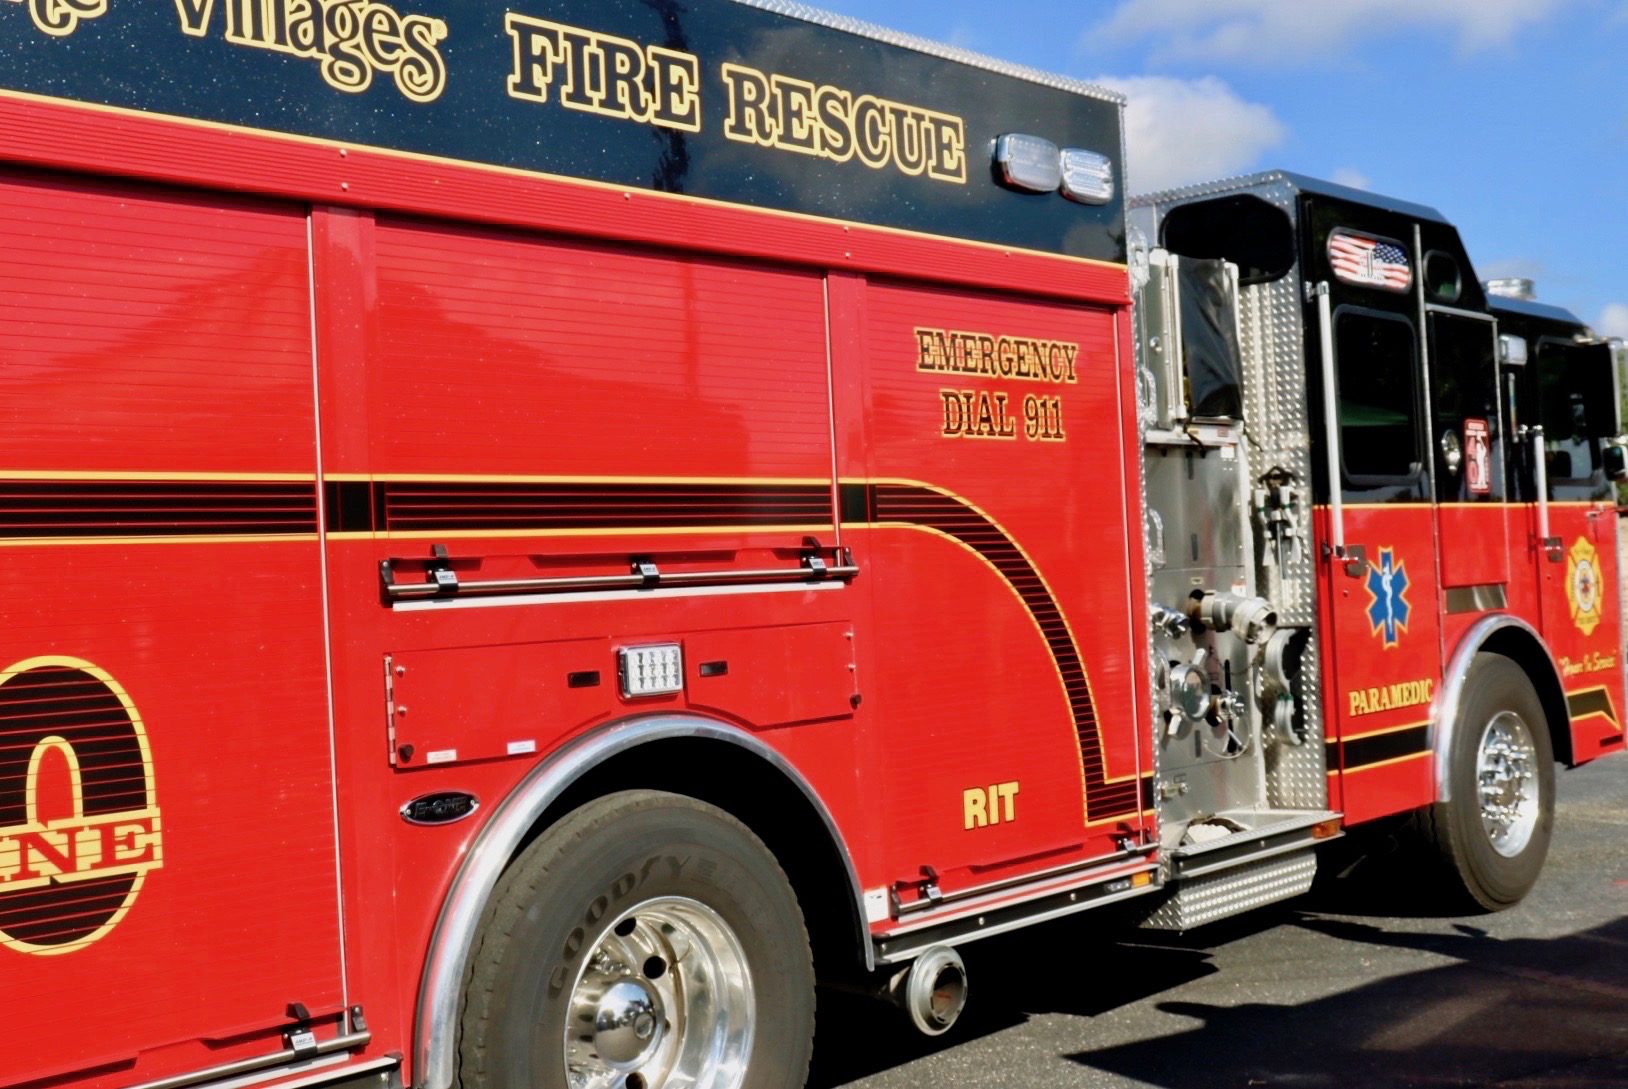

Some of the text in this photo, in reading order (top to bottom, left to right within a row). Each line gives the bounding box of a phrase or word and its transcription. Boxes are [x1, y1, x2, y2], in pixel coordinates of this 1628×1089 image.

[504, 12, 701, 133] FIRE
[721, 62, 967, 185] RESCUE
[913, 326, 1079, 384] EMERGENCY
[939, 388, 1066, 443] DIAL 911
[1348, 678, 1434, 717] PARAMEDIC
[962, 780, 1020, 831] RIT
[0, 810, 160, 890] NE
[547, 853, 768, 1000] GOODYEA
